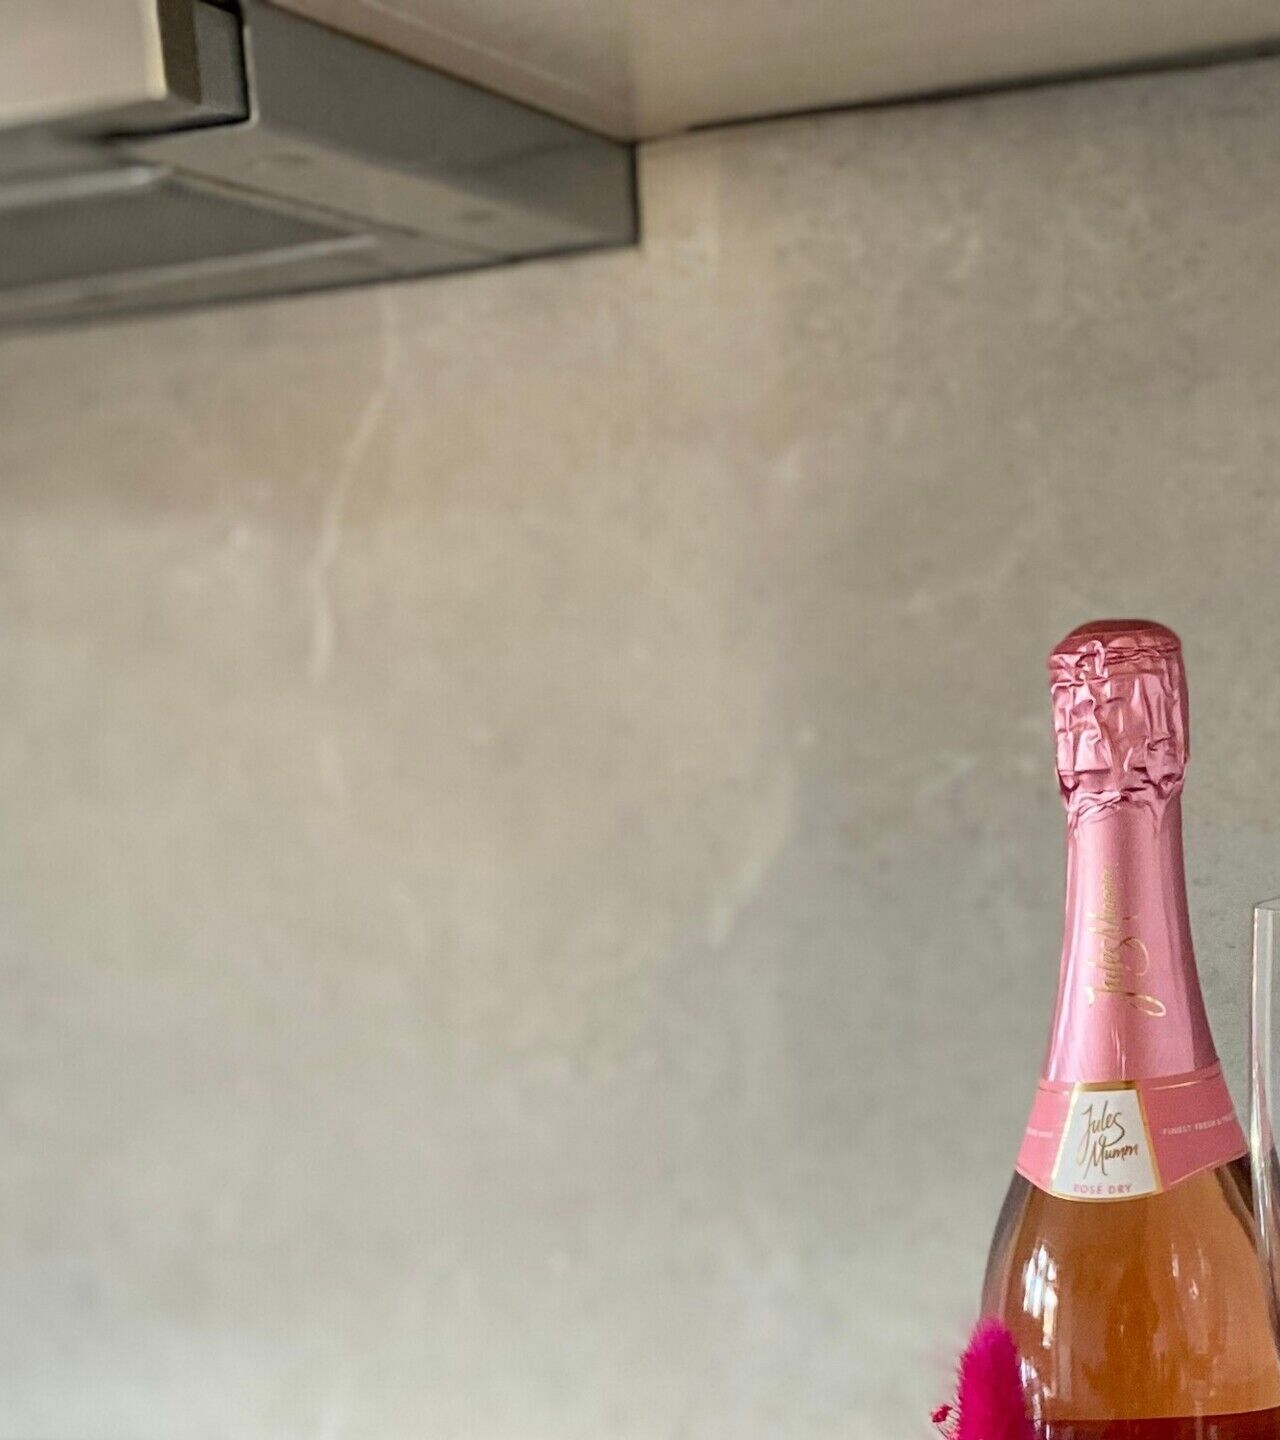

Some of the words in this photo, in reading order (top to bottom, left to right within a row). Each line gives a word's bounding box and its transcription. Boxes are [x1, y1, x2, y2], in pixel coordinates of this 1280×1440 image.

[1077, 1100, 1125, 1166] Jules
[1083, 1134, 1139, 1180] Mumm
[1108, 1184, 1133, 1195] DRY
